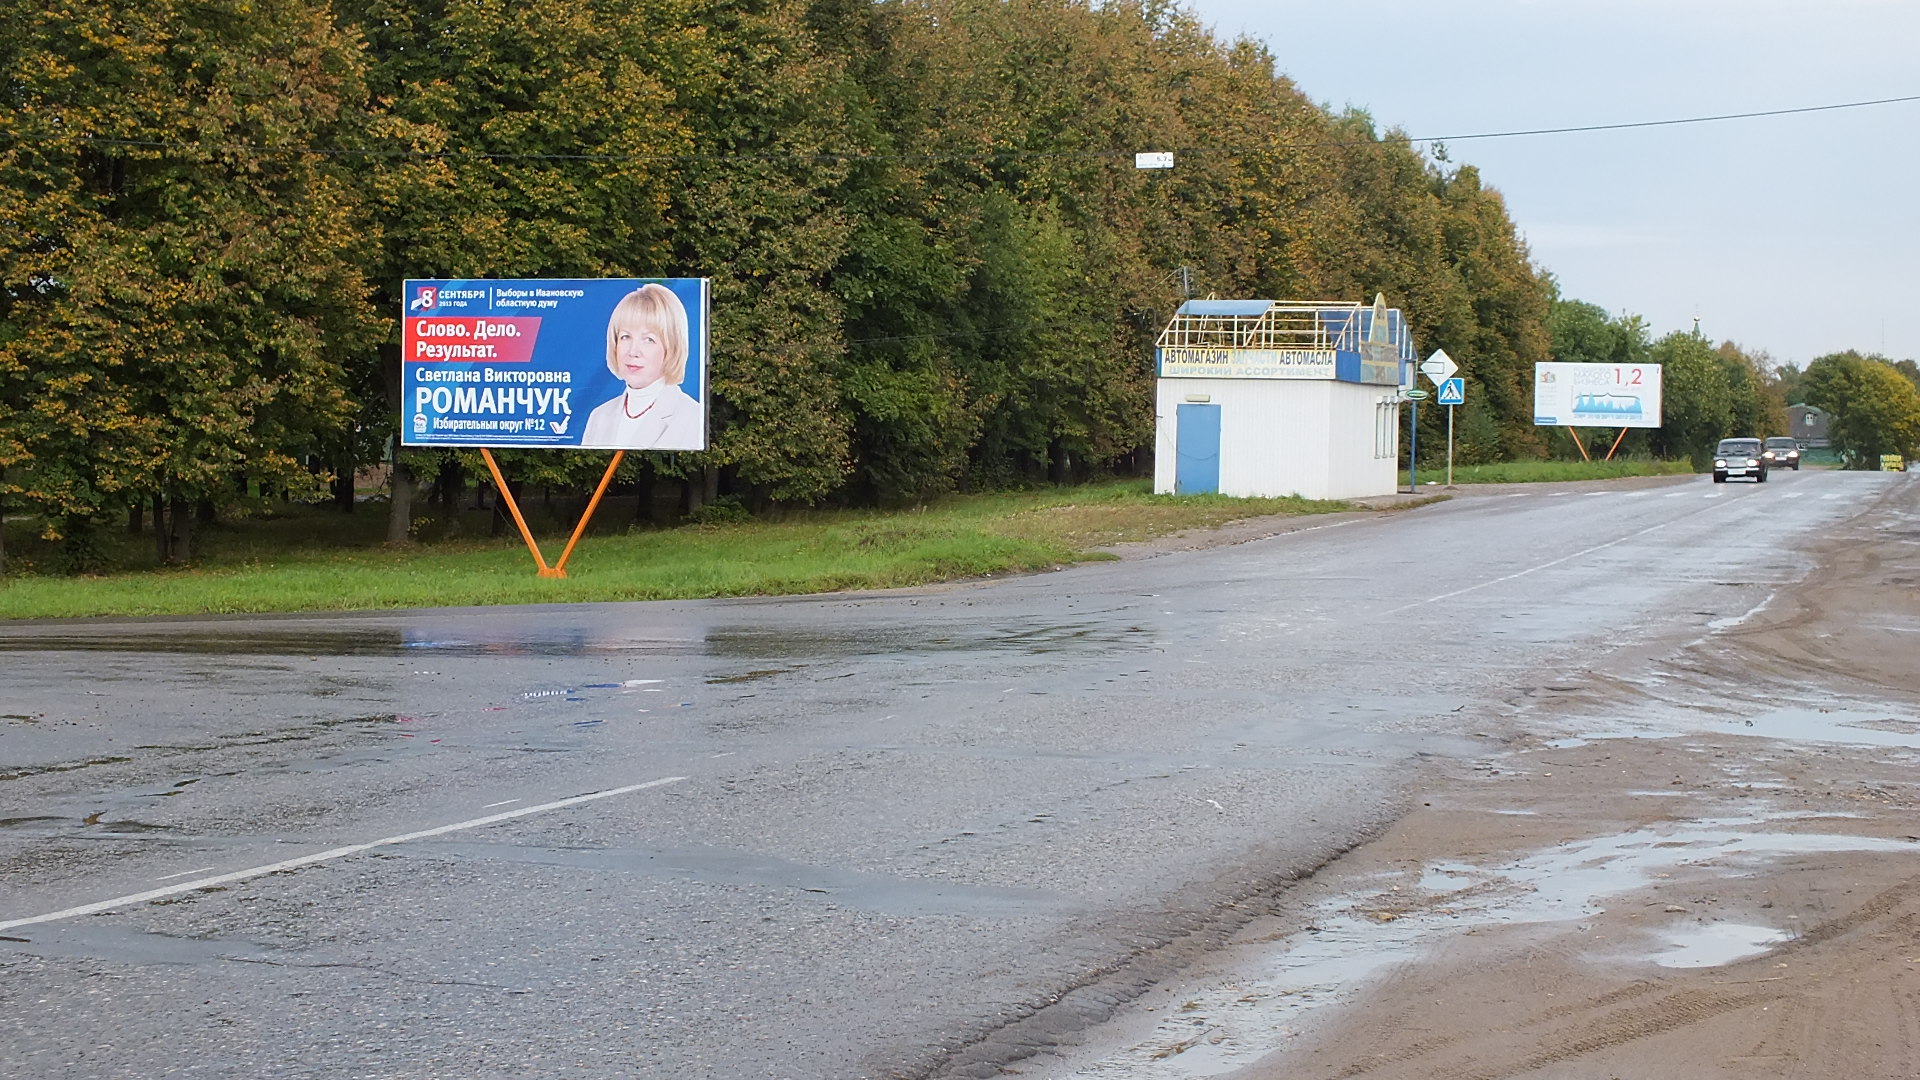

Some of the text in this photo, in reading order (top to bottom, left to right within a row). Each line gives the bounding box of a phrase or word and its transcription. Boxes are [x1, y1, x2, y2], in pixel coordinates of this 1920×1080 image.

[422, 290, 434, 308] 8
[438, 290, 486, 299] СЕНТЯБРЯ
[496, 288, 527, 299] Выборы
[535, 288, 584, 299] Ивановскую
[496, 299, 558, 309] областную думу
[416, 320, 521, 341] Слово. Дело.
[416, 341, 498, 362] Результат.
[1164, 349, 1229, 364] АВТОМАГАЗИН
[1279, 351, 1333, 365] АВТОМАСЛА
[415, 367, 571, 386] Светлана Викторовна
[1169, 365, 1330, 377] ШИРОКИЙ АССОРТИМЕНТ
[1614, 368, 1642, 386] 1,2
[416, 386, 572, 415] РОМАНЧУК
[499, 420, 524, 433] округ
[525, 418, 545, 431] №12
